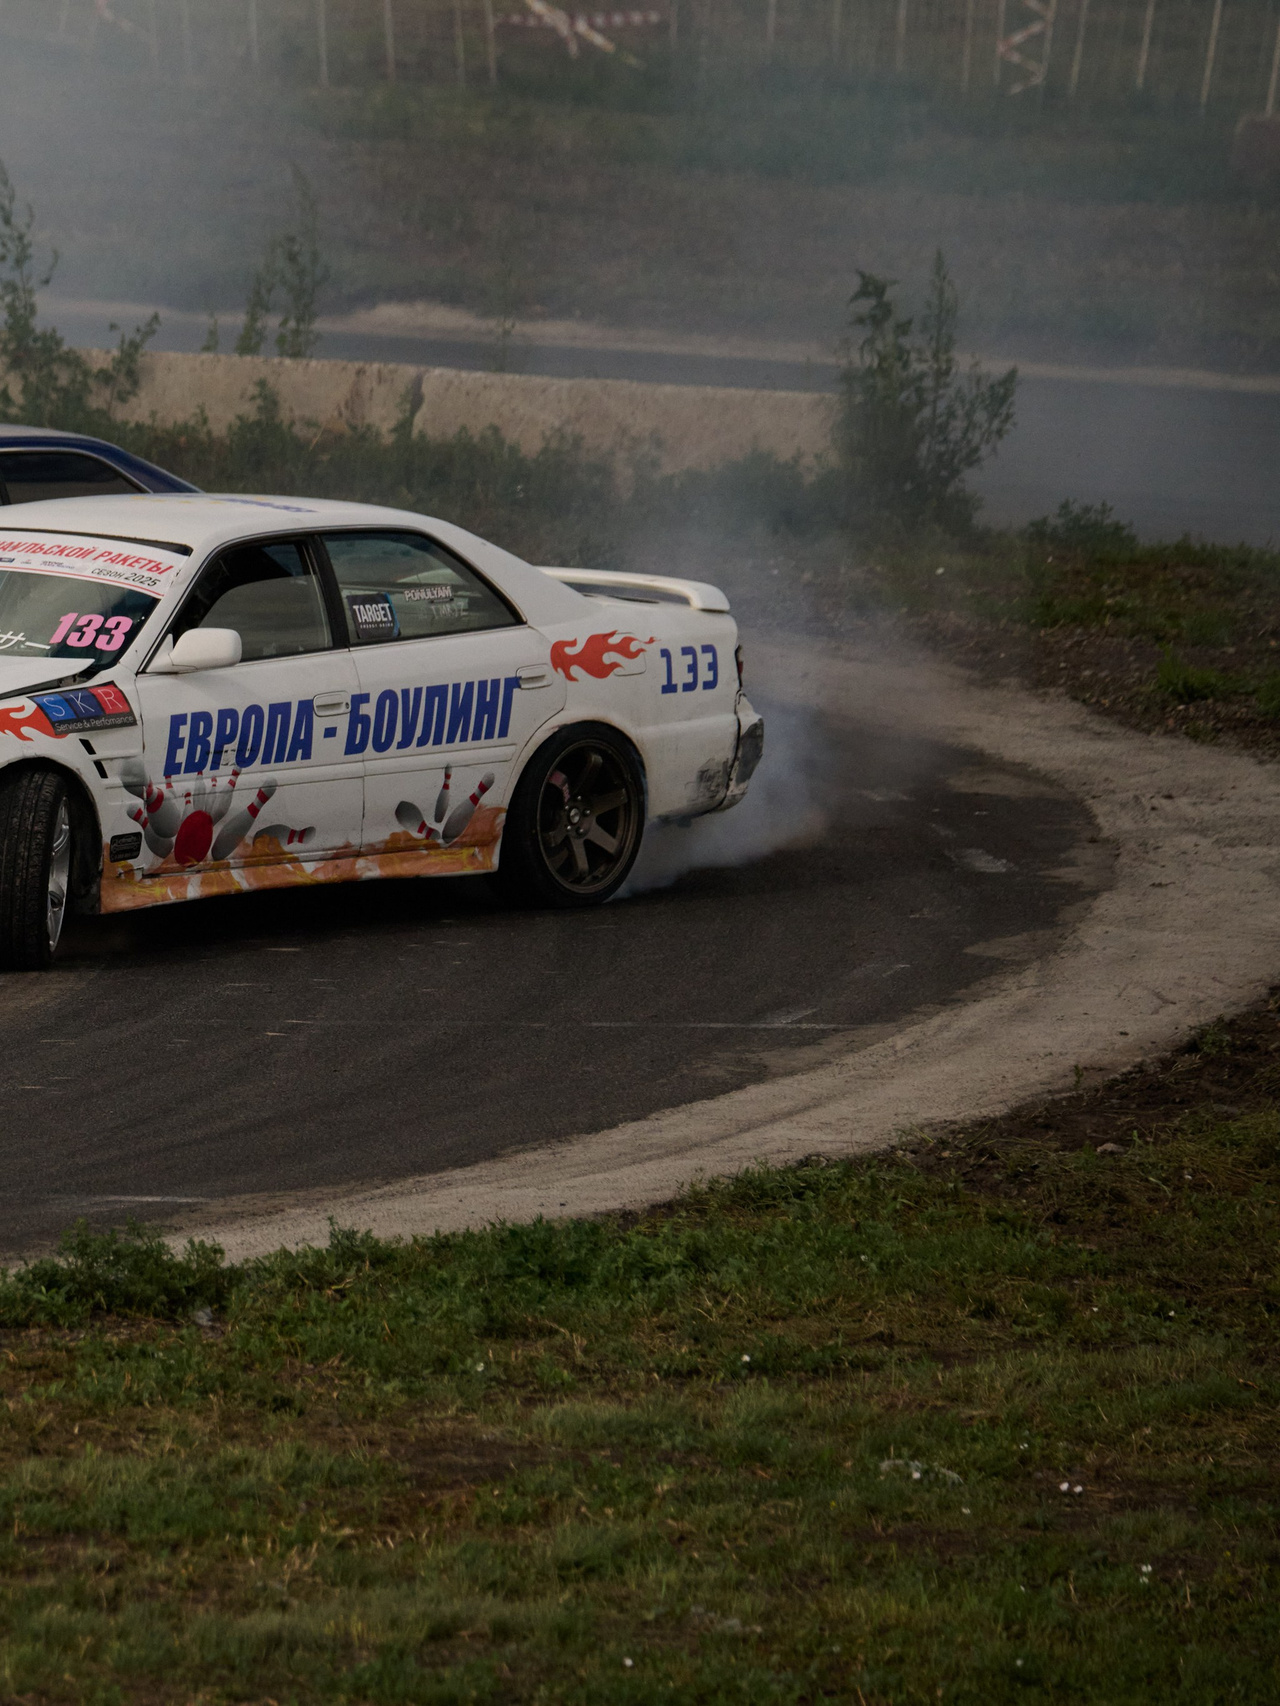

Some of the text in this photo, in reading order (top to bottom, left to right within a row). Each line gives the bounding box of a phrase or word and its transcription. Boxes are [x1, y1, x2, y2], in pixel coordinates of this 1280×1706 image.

[94, 550, 174, 575] РАКЕТЫ
[91, 567, 161, 587] СЕЗОН 2025
[354, 604, 393, 623] TARGET
[48, 612, 134, 652] 133
[660, 644, 719, 694] 133
[43, 688, 123, 718] SKR
[54, 722, 83, 732] Service
[83, 719, 91, 729] &
[163, 699, 314, 777] ЕВРОПА
[344, 676, 522, 756] БОУЛИНГ
